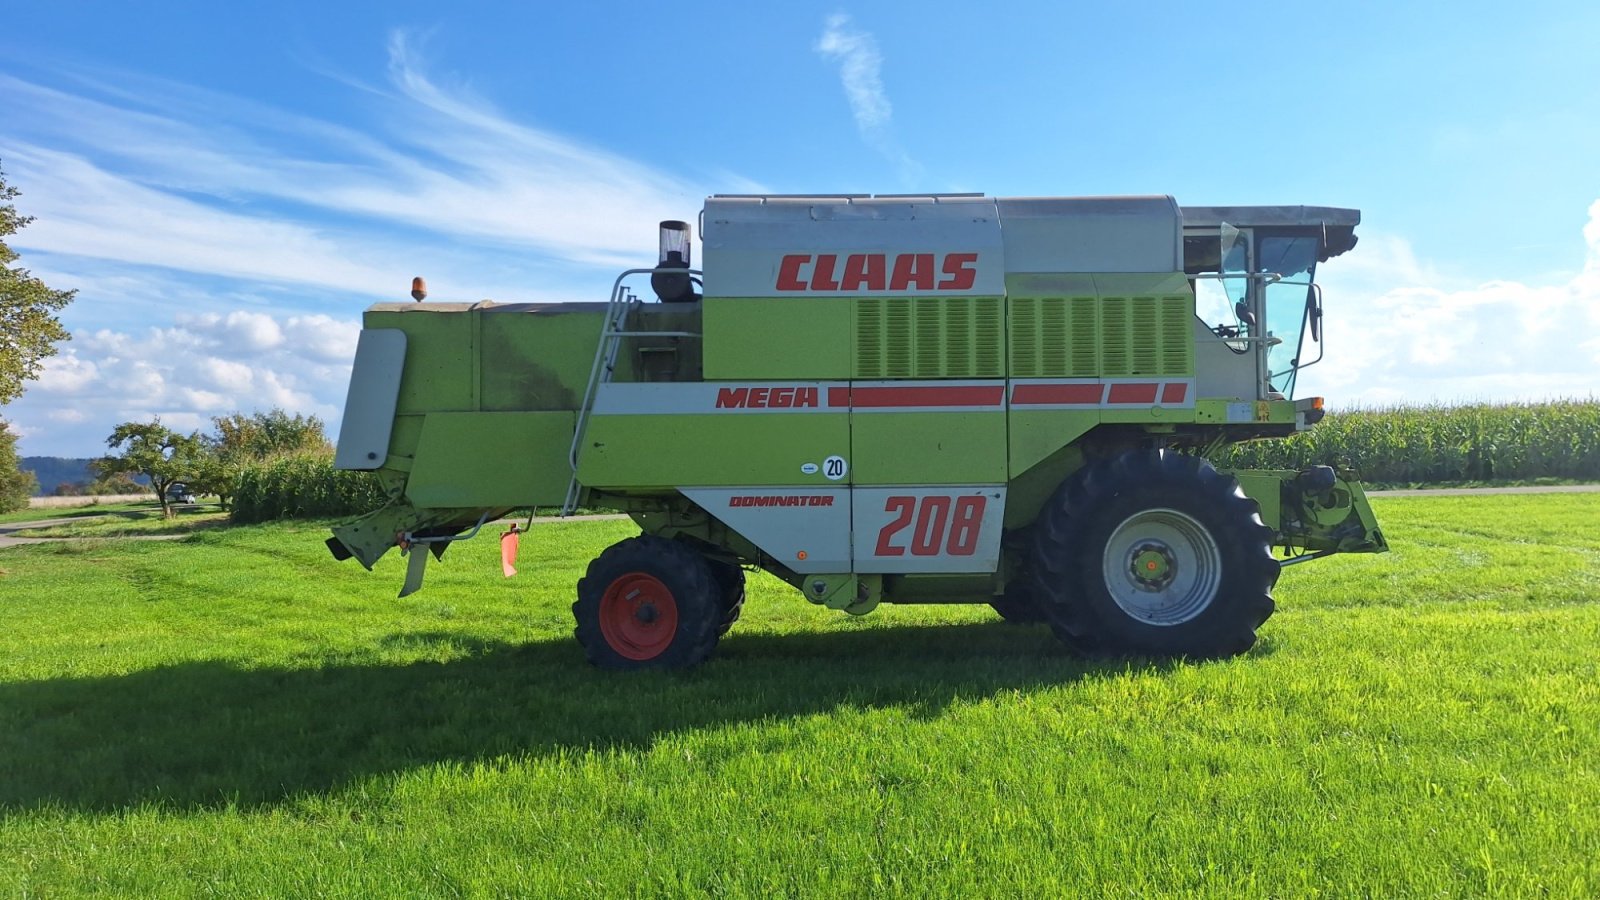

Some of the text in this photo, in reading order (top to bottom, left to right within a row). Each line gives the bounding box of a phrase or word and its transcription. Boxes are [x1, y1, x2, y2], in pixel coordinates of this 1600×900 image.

[777, 254, 977, 291] CLAAS
[716, 387, 818, 408] MEGA
[827, 459, 843, 476] 20
[729, 495, 834, 507] DOMINATOR
[875, 496, 986, 556] 208
